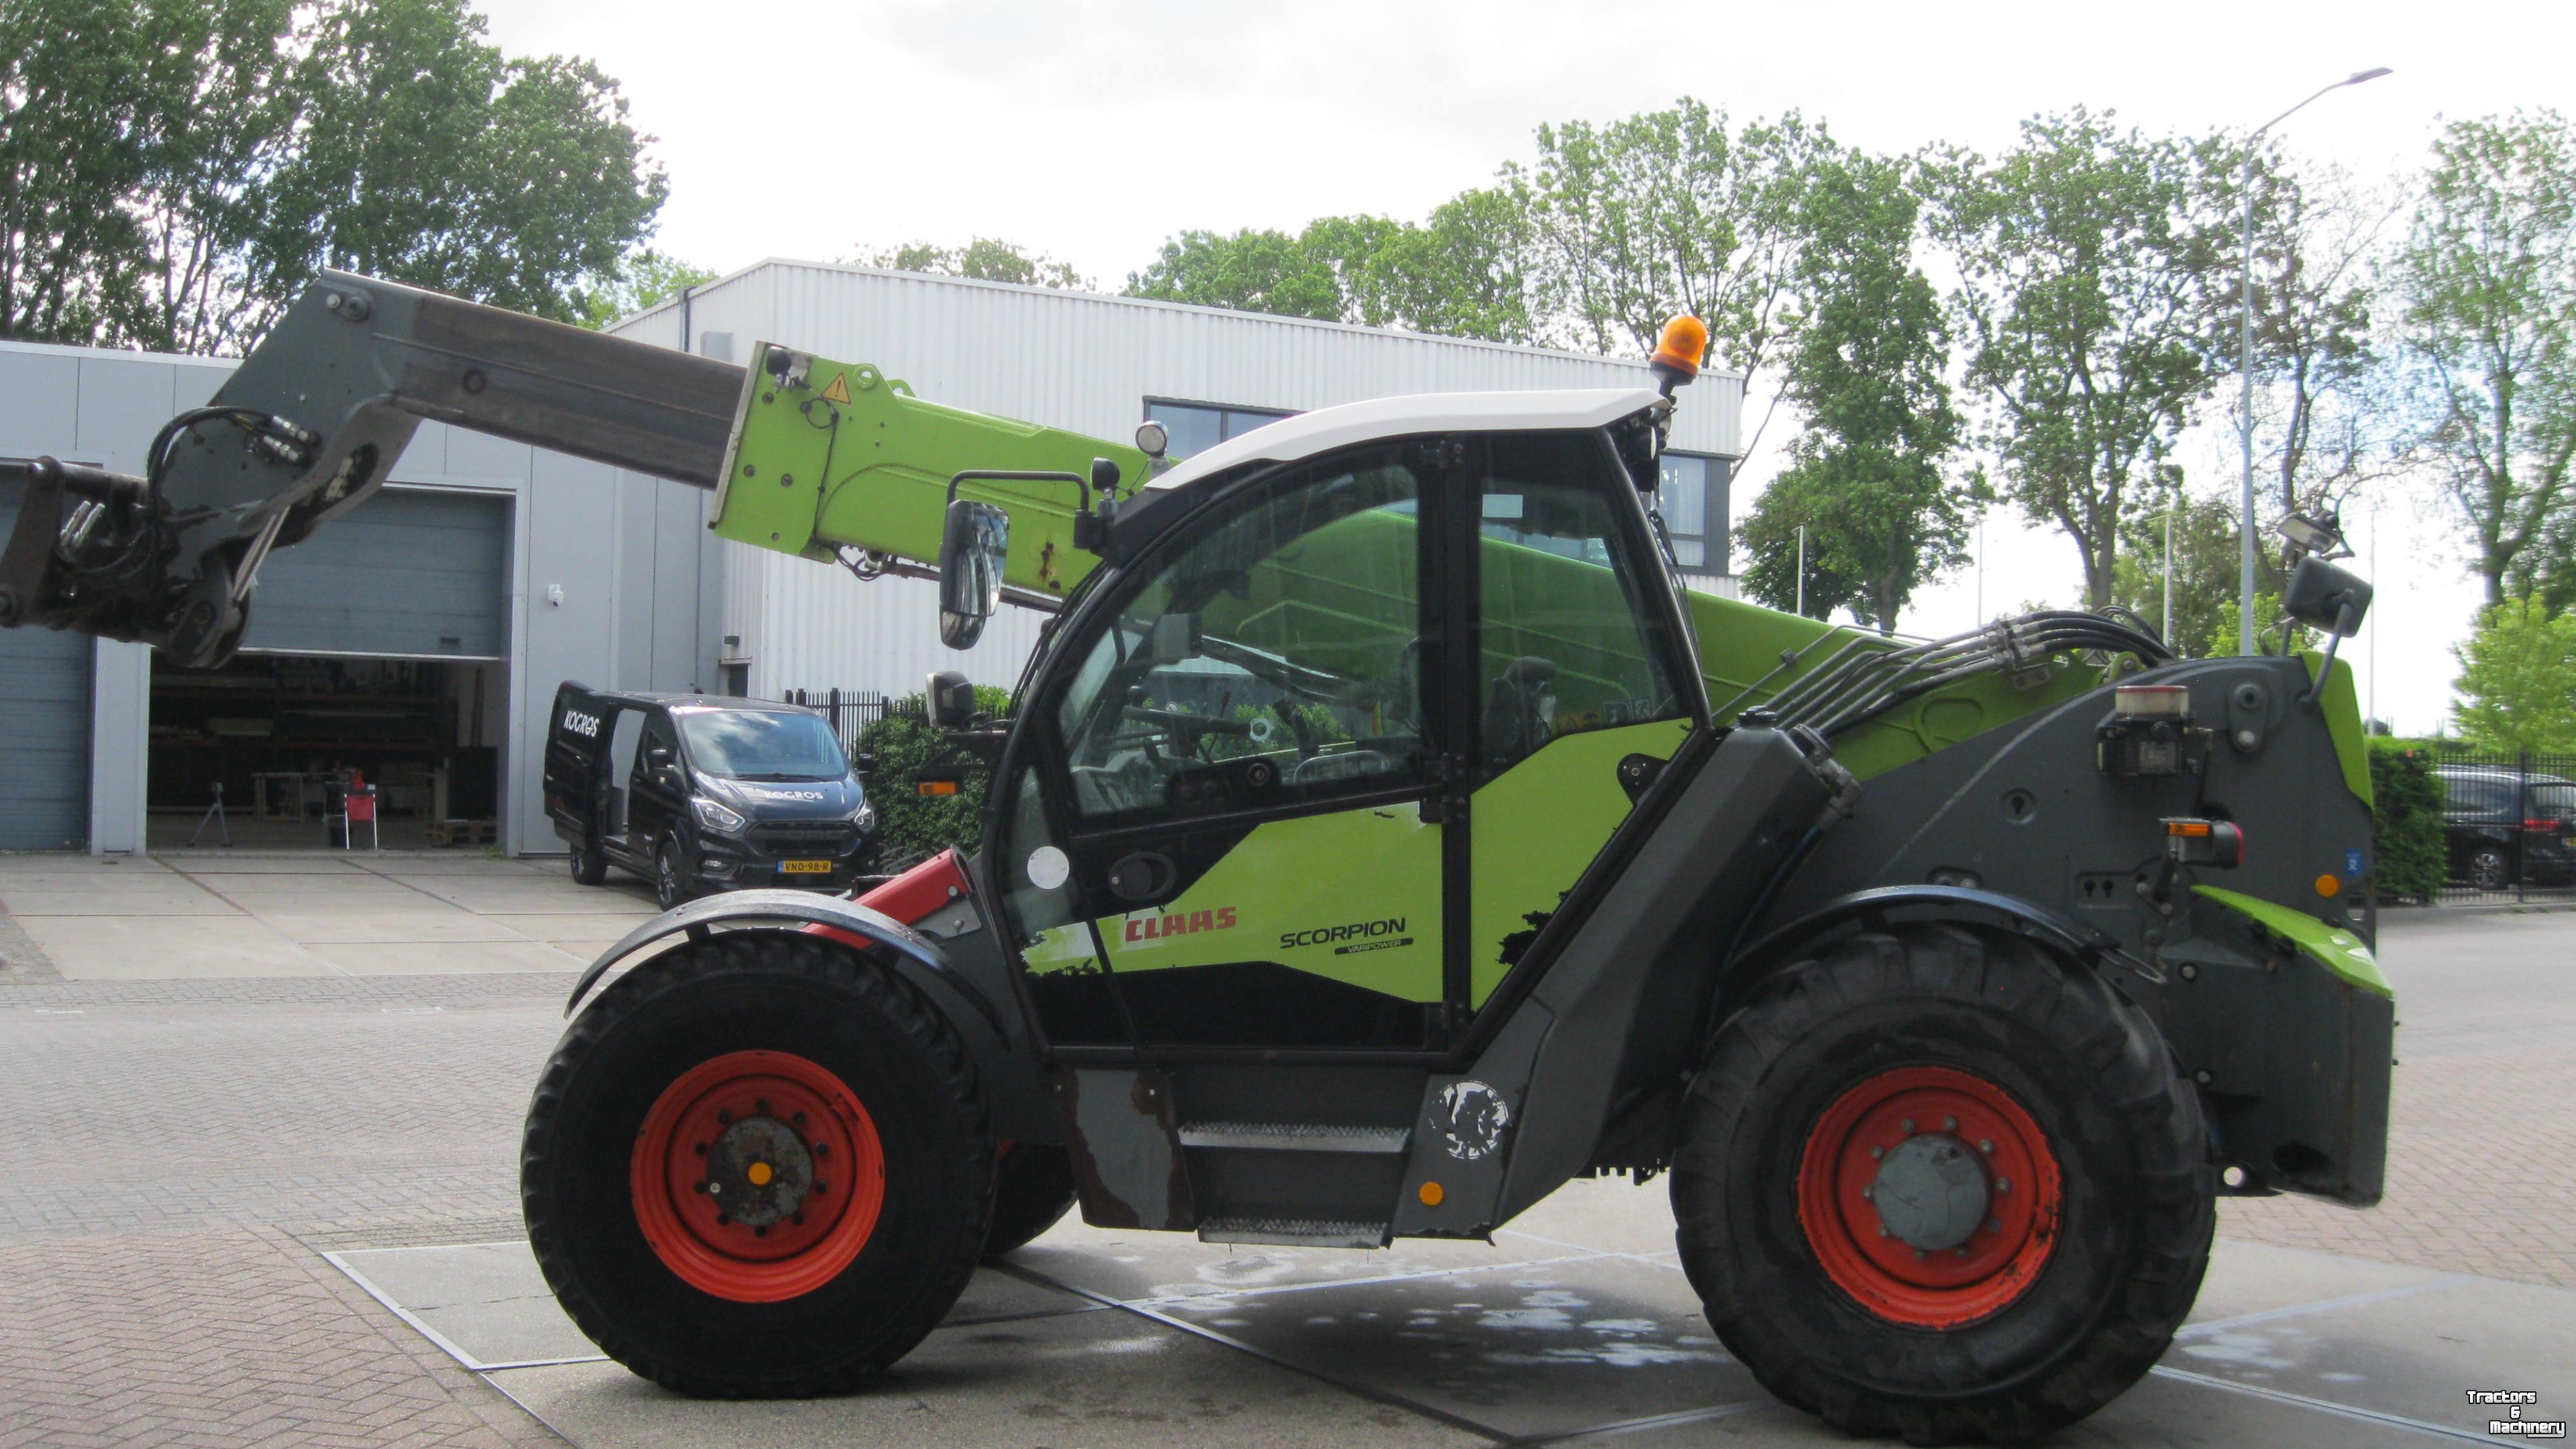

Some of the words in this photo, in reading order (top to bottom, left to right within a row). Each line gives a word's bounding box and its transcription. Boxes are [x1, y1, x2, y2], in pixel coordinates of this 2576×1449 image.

[564, 710, 600, 737] KOGROS
[765, 791, 824, 800] KOGROS
[785, 862, 828, 871] VND-98-R
[1125, 906, 1236, 942] CLAAS
[1279, 918, 1406, 949] SCORPION
[1347, 940, 1401, 953] VARIPOWER
